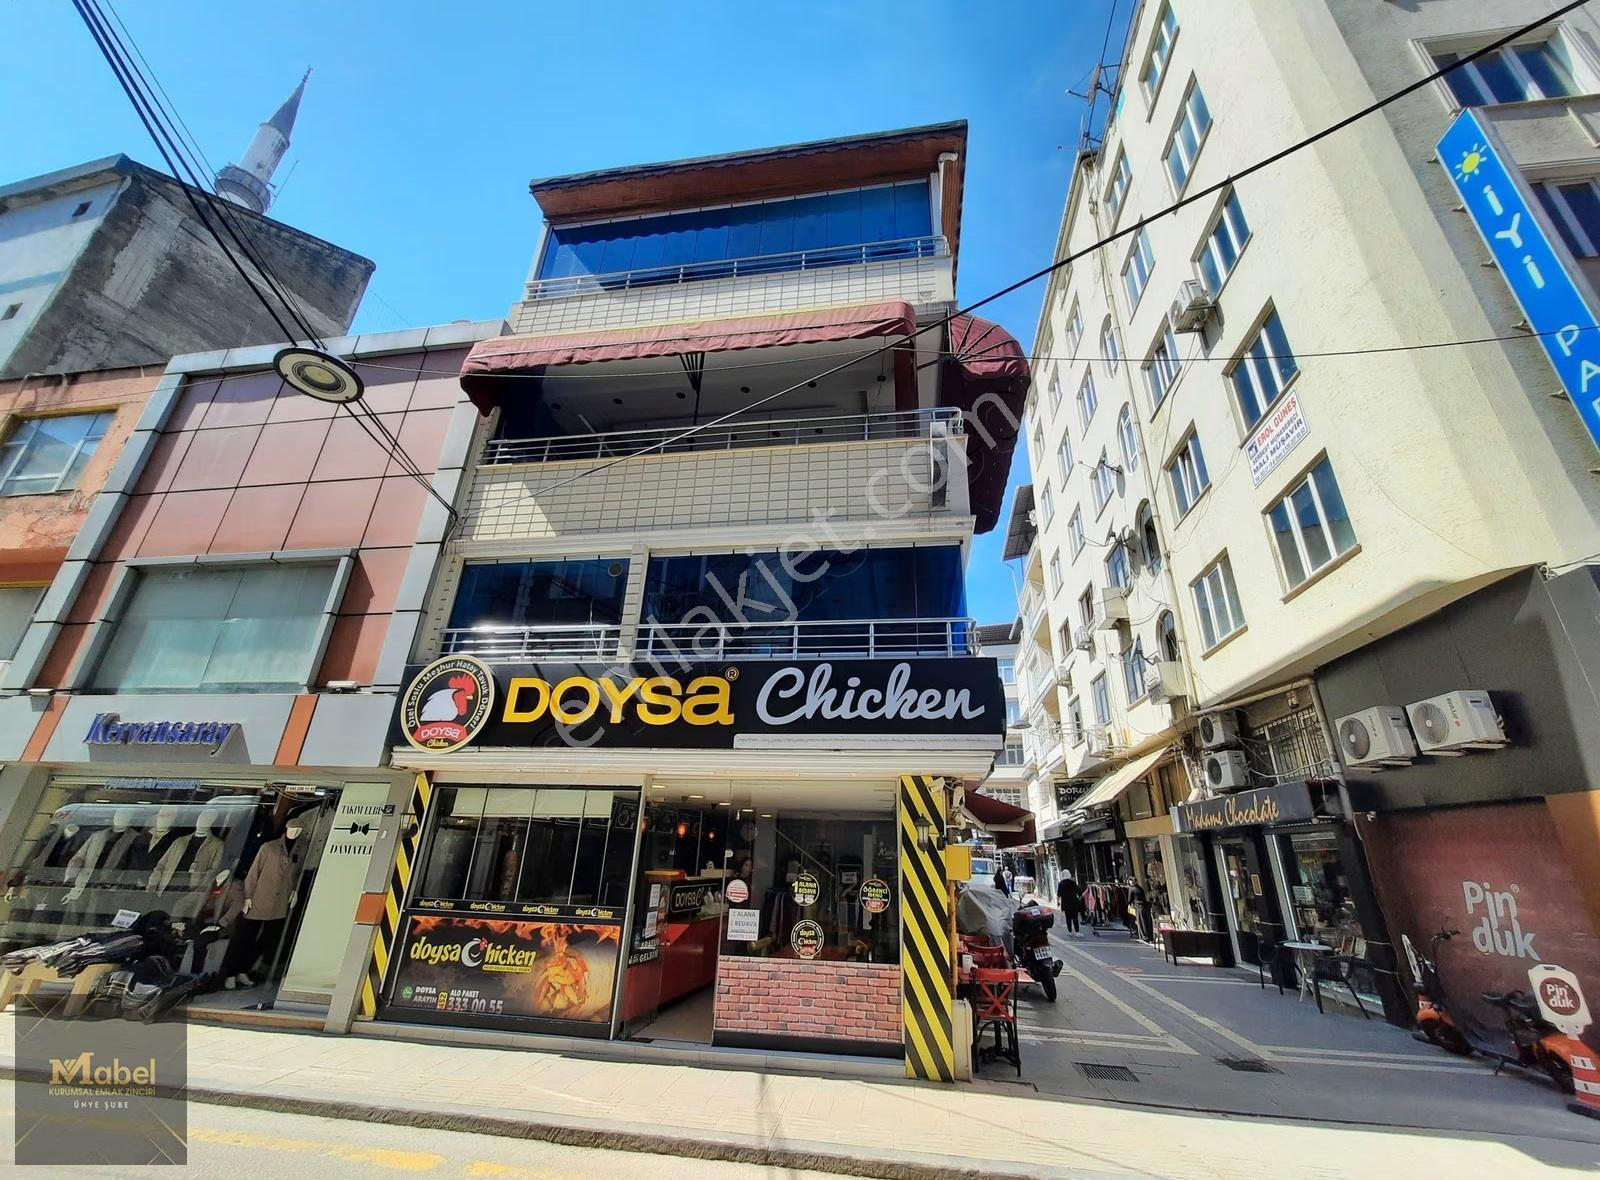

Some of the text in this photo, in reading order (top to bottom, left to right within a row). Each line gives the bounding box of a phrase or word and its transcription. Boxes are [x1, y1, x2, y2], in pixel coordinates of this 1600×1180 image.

[1555, 324, 1600, 418] PA
[1257, 425, 1274, 446] EROL
[755, 662, 985, 726] Chicken
[82, 712, 243, 757] Kervansaray
[1185, 792, 1280, 829] Madame Chocolate
[330, 844, 373, 855] DAMATLI
[1472, 916, 1541, 962] duk
[1546, 983, 1570, 1001] Pin
[1549, 996, 1575, 1009] duk
